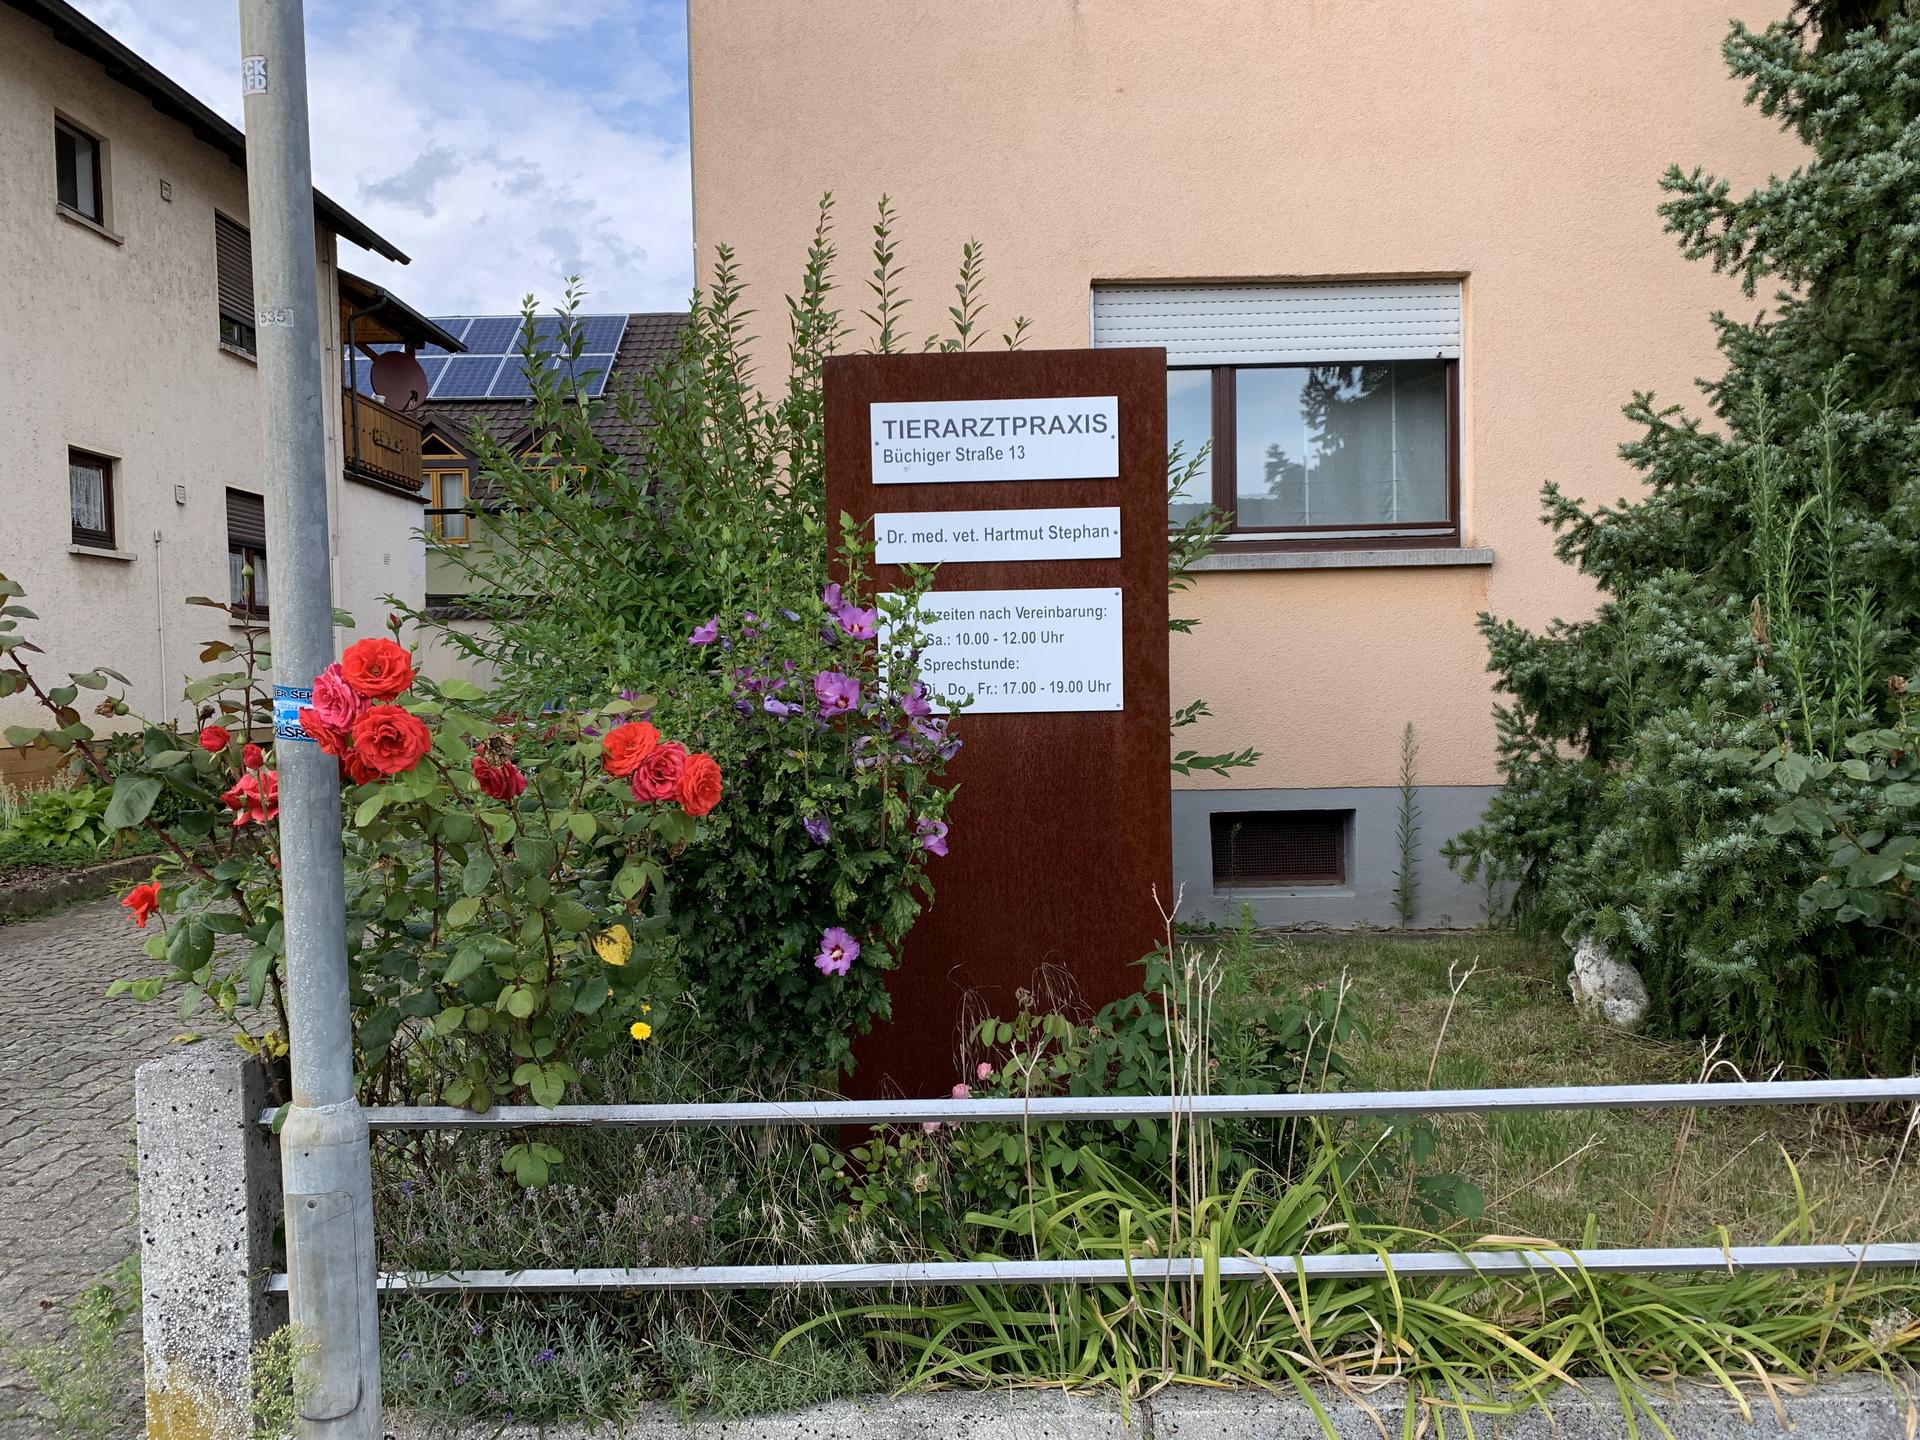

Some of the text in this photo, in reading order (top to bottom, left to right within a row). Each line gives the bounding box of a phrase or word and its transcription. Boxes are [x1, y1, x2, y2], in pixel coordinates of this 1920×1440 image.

[882, 413, 1108, 440] TIERARZTPRAXIS
[883, 445, 1026, 466] Büchiger Straße 13
[887, 524, 1110, 544] Dr. med. vet. Hartmut Stephan
[979, 607, 1011, 620] nach
[1015, 605, 1107, 621] Vereinbarung:
[926, 633, 951, 646] Sa.:
[955, 632, 990, 646] 10.00
[1002, 631, 1037, 645] 12.00
[1041, 630, 1065, 644] Uhr
[923, 656, 1020, 674] Sprechstunde:
[978, 682, 998, 695] Fr.:
[1002, 681, 1036, 695] 17.00
[1050, 680, 1084, 694] 19.00
[1087, 679, 1112, 693] Uhr
